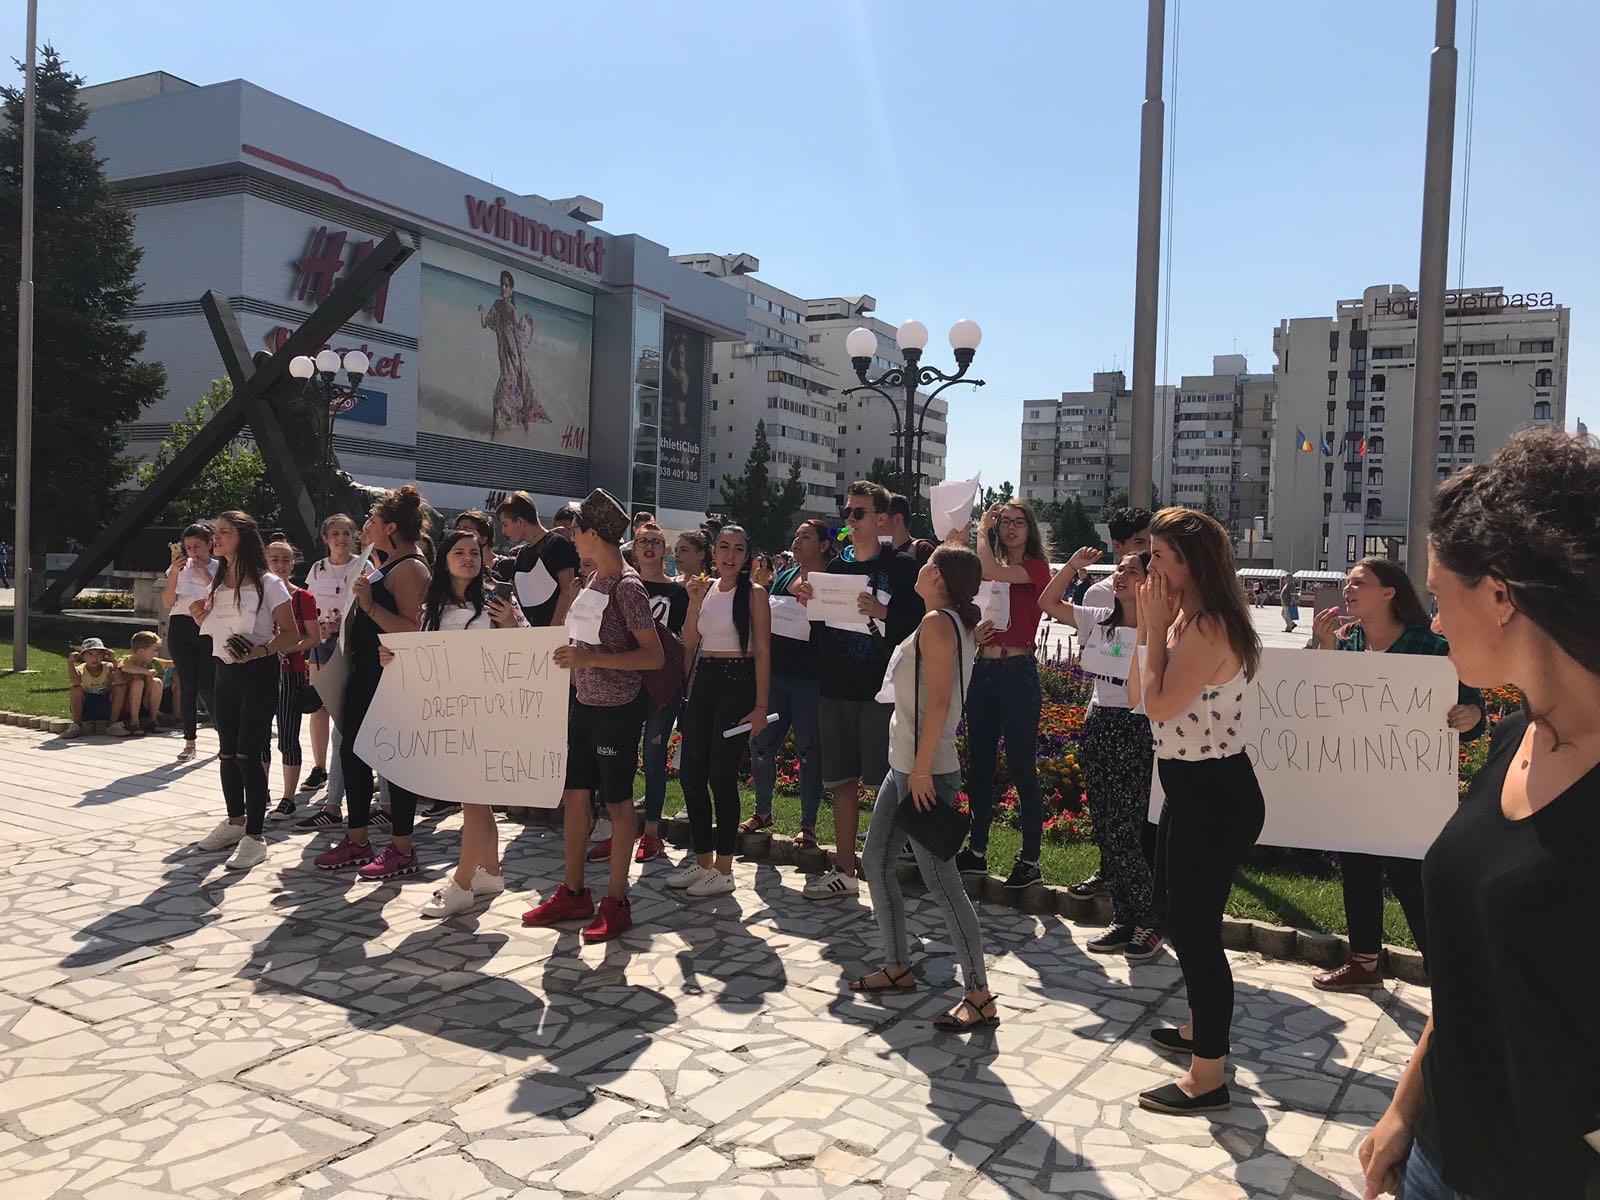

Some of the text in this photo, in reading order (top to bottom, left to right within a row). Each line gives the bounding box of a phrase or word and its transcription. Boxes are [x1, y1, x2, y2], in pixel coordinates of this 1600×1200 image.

[465, 194, 605, 274] winmarkt
[561, 424, 585, 452] H&M
[672, 469, 684, 478] 401
[480, 646, 549, 684] AVEM
[374, 726, 477, 762] SUNTEM
